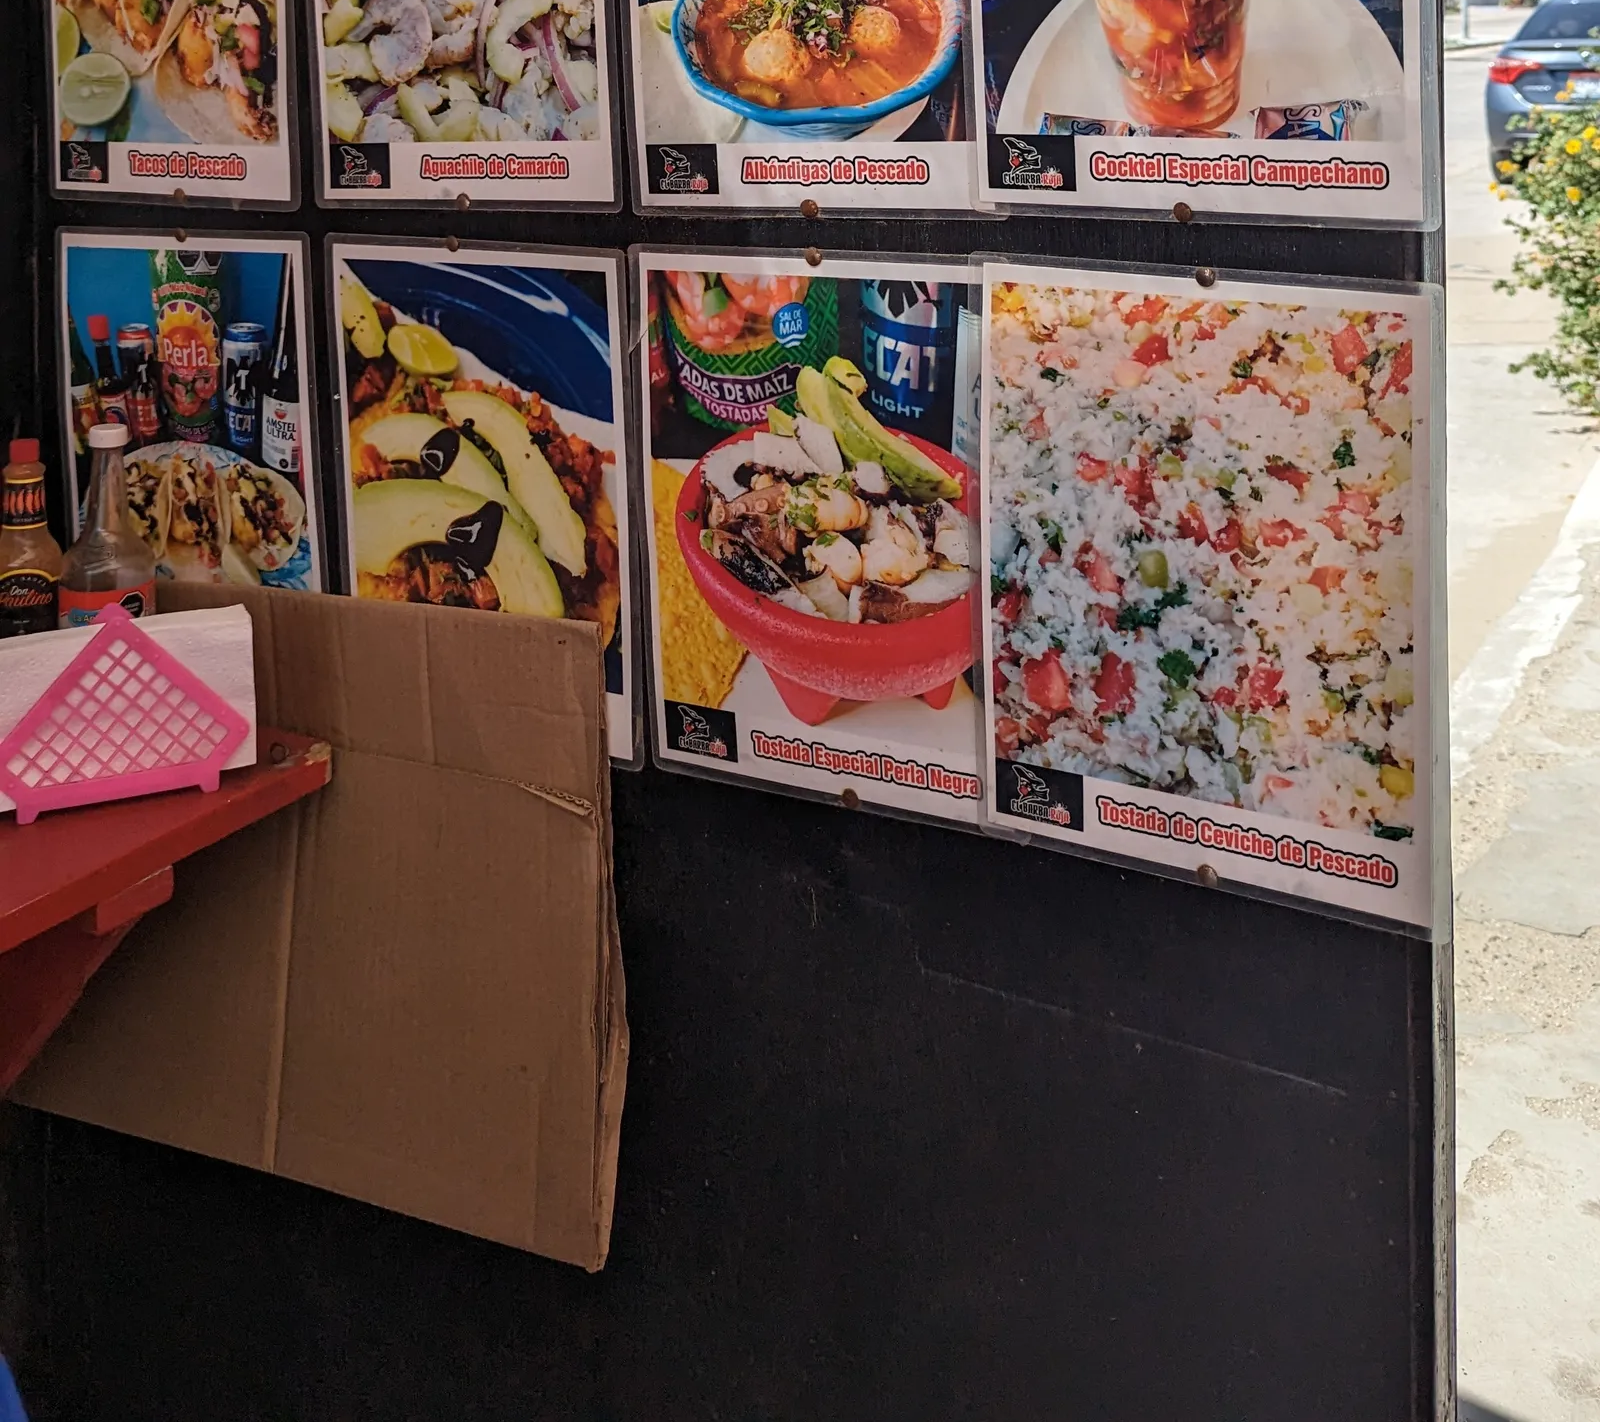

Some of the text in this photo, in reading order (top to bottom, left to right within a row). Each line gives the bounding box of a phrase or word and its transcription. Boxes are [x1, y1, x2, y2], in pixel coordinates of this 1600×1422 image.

[130, 152, 245, 178] Tacos de Pescado
[423, 155, 566, 178] Aguachile de Camarón
[744, 158, 926, 183] Albóndigas de Pescado
[1094, 155, 1384, 187] Cocktel Especial Campechano
[1003, 172, 1014, 185] EL
[1014, 173, 1041, 185] BARBA
[778, 310, 791, 321] SAL
[779, 319, 803, 335] MAR
[164, 338, 208, 367] Perla
[723, 382, 745, 404] DE
[746, 372, 793, 402] MAÍZ
[704, 398, 767, 423] TOSTADAS
[871, 389, 924, 419] LIGHT
[266, 417, 297, 433] AMSTEL
[267, 426, 296, 442] ULTRA
[10, 586, 28, 596] Don
[754, 734, 978, 797] Tostada Especial Perla Negra
[1011, 798, 1021, 812] EL
[1022, 802, 1049, 819] BARBA
[1100, 800, 1393, 883] Tostada de Ceviche de Pescado
